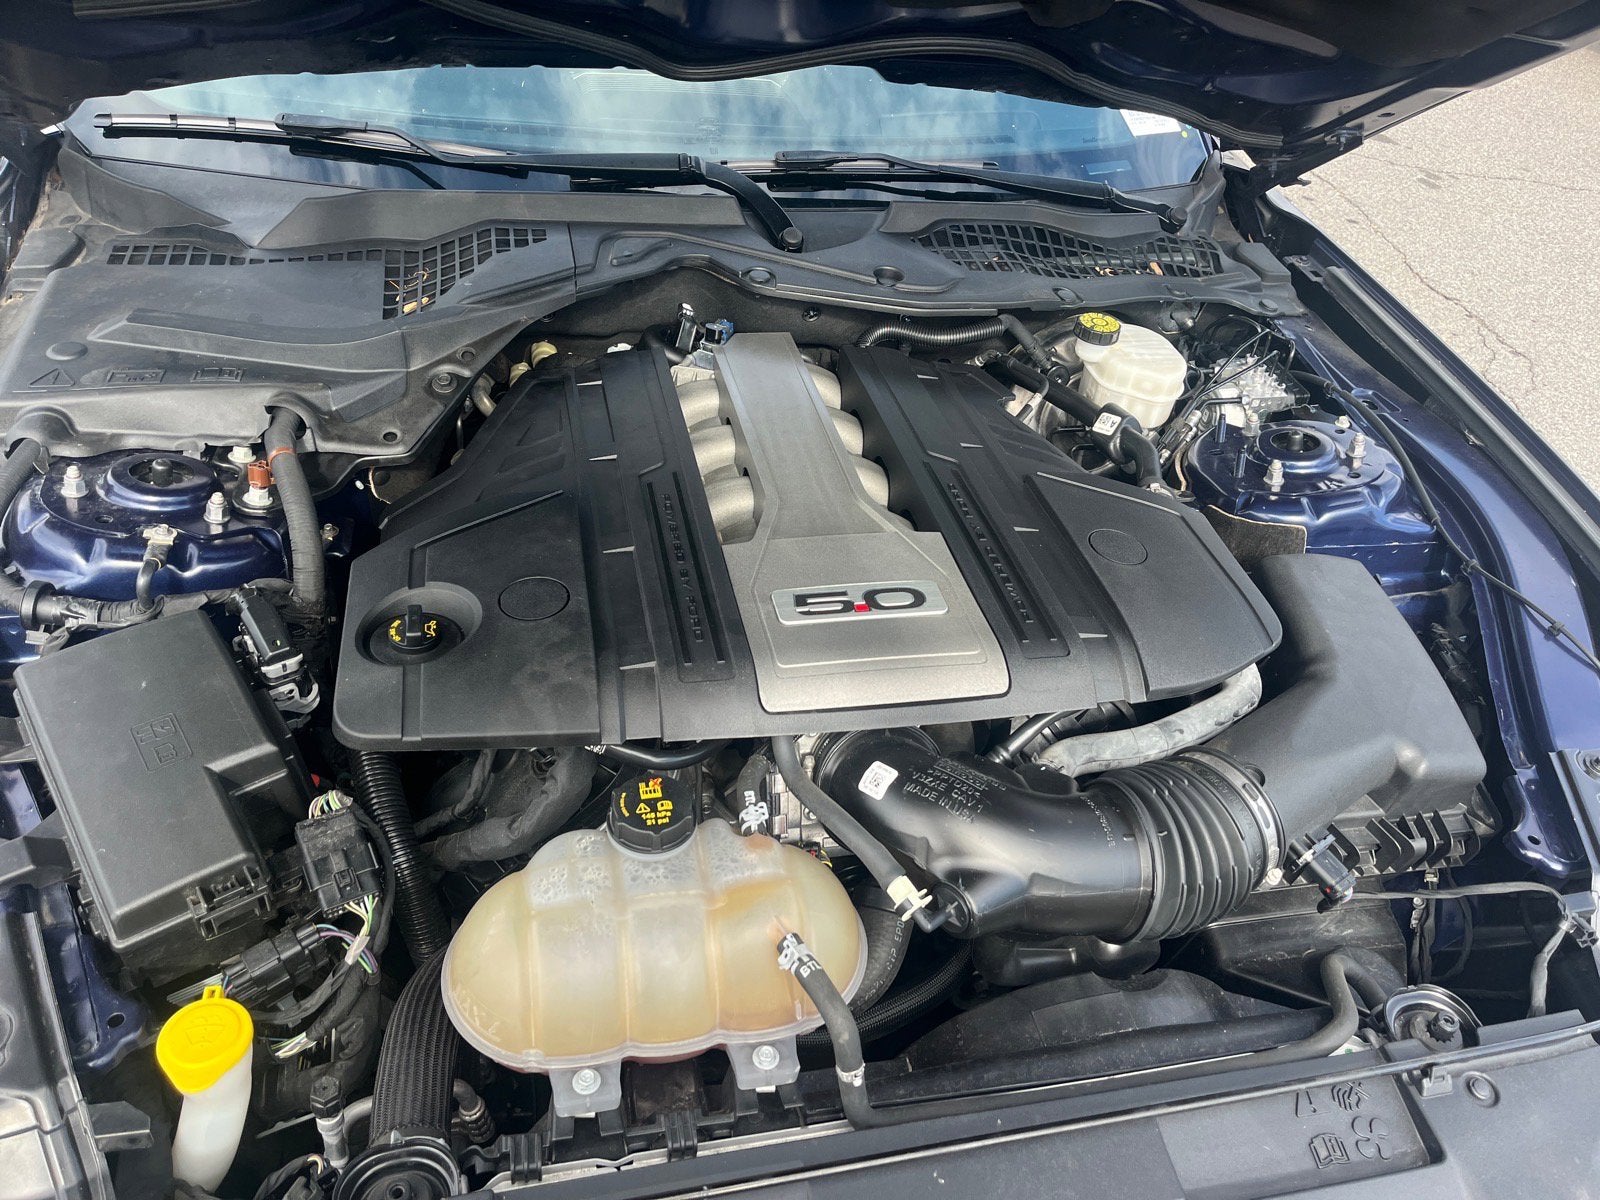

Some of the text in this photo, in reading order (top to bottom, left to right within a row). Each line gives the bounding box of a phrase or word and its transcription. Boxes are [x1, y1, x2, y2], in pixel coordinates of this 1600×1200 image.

[793, 587, 927, 615] 5.0
[903, 782, 939, 802] MADE
[894, 917, 905, 943] EPD
